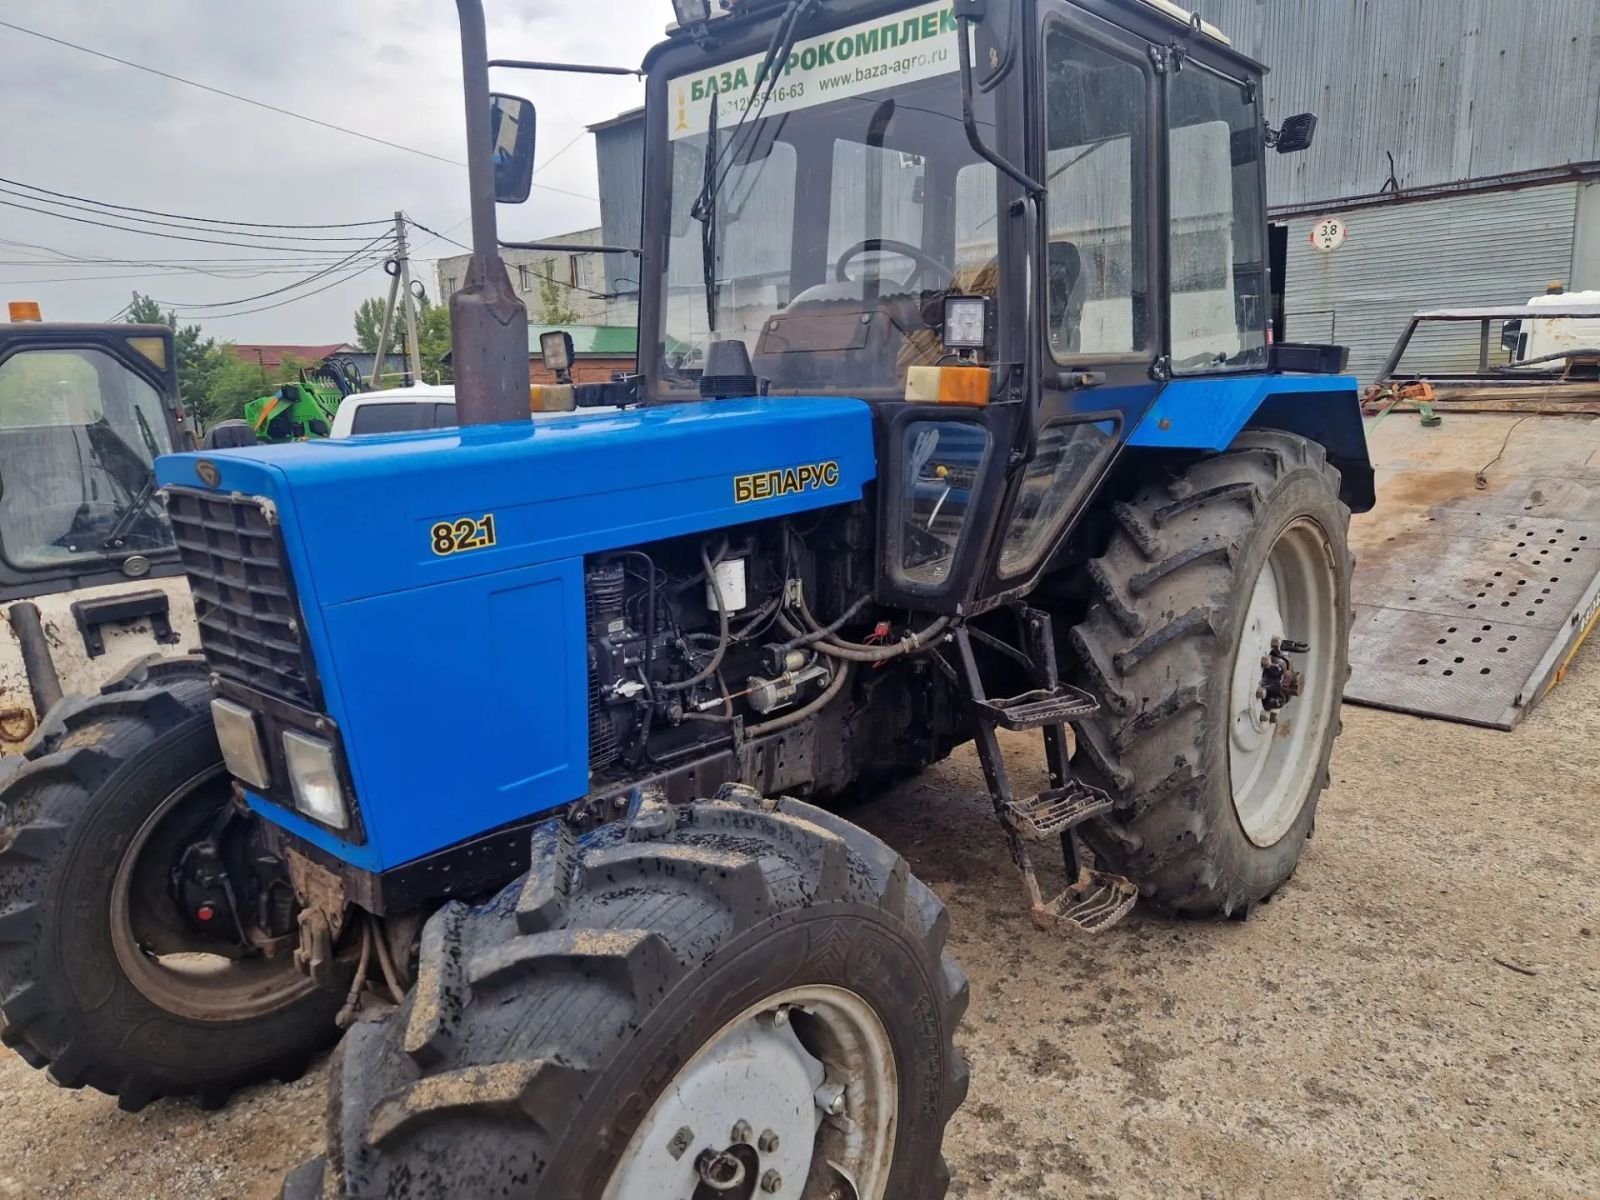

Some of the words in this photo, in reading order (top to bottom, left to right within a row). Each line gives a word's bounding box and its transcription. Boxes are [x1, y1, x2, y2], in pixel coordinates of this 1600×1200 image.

[691, 66, 749, 102] БАЗА
[819, 48, 948, 92] www.baza-agro.ru
[734, 461, 839, 503] БЕЛАРУС
[431, 513, 496, 556] 82.1
